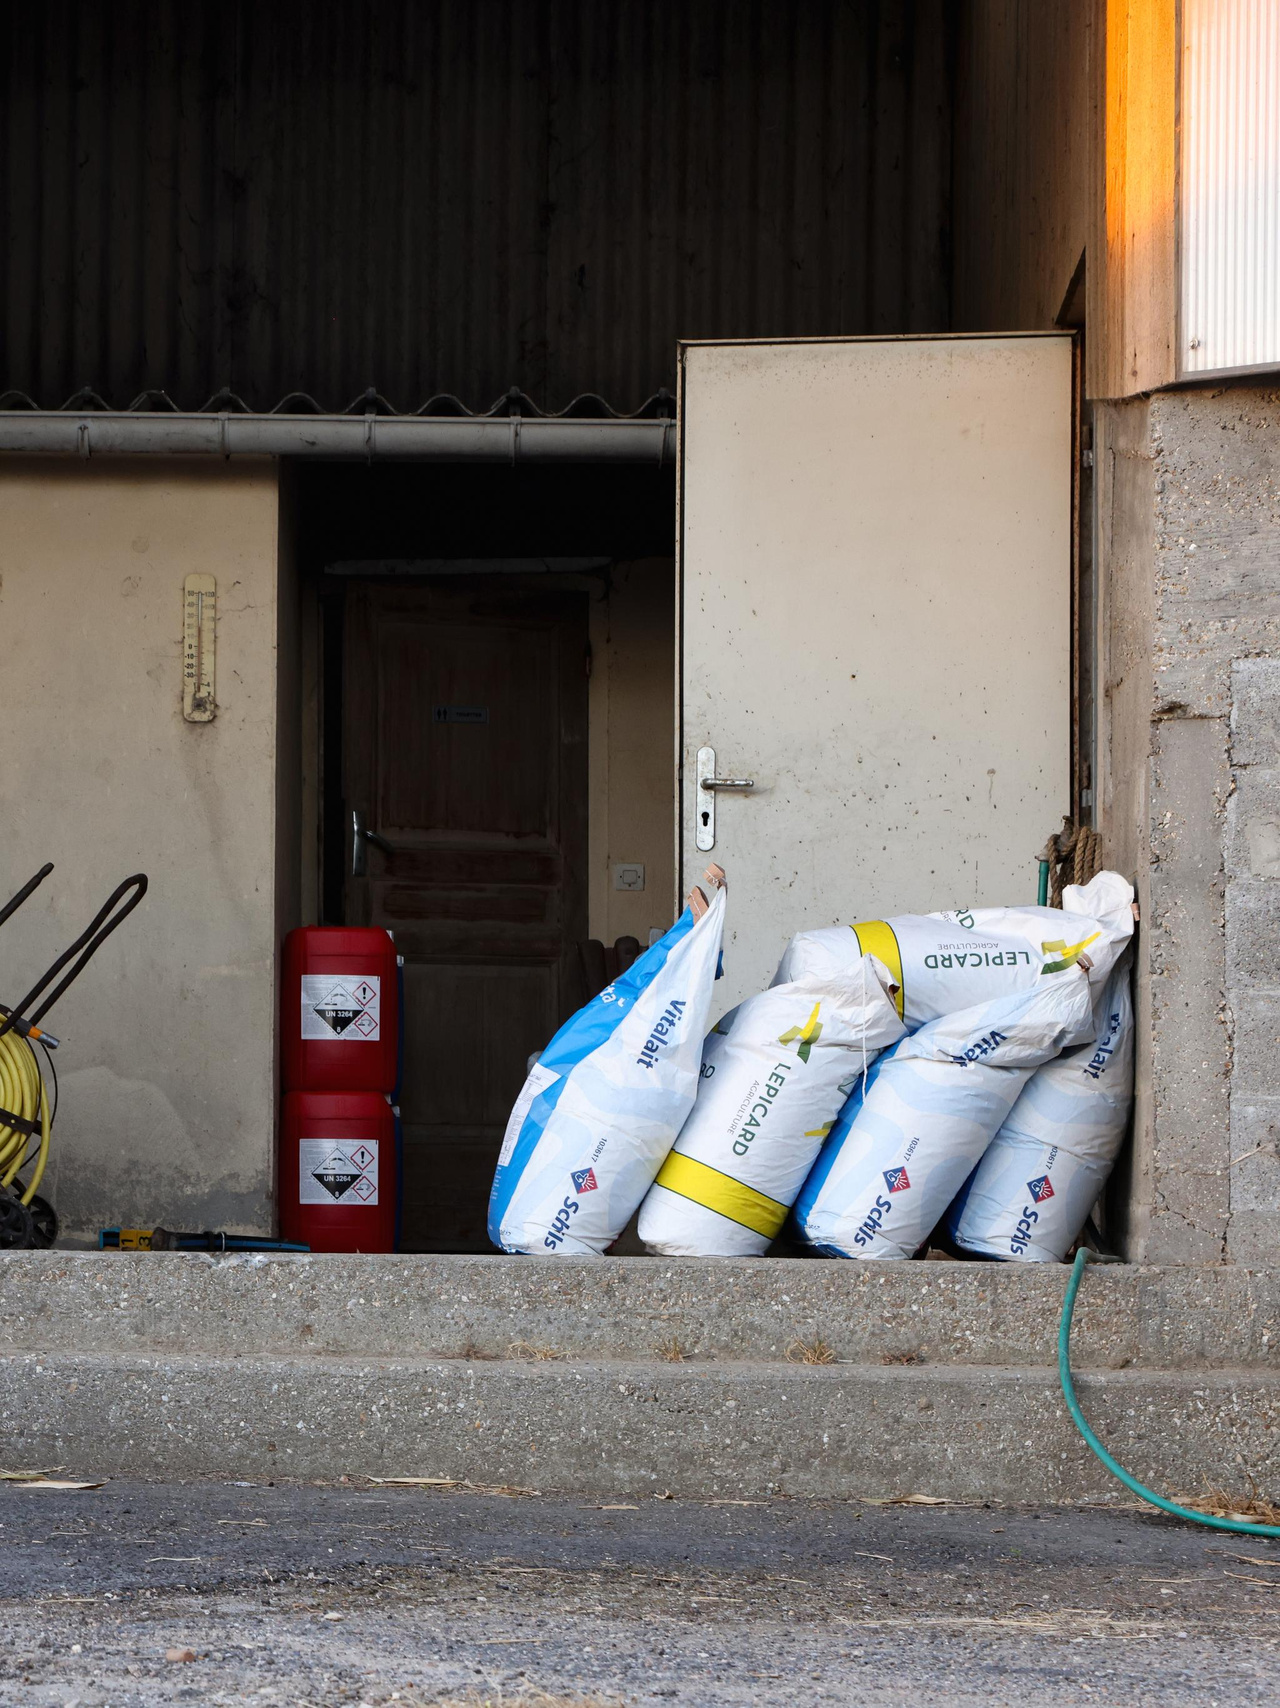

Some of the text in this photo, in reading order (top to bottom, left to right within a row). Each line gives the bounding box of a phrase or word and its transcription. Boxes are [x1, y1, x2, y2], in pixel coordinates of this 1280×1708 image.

[937, 942, 999, 951] AGRICULTURE
[924, 951, 1030, 969] LEPICARD
[325, 1010, 353, 1018] UN 3264
[636, 999, 687, 1069] Vitalait
[726, 1079, 760, 1136] AGRICULTURE
[732, 1062, 792, 1156] LEPICARD
[591, 1137, 608, 1163] 103617
[903, 1136, 920, 1162] 103617
[854, 1195, 892, 1247] Schls
